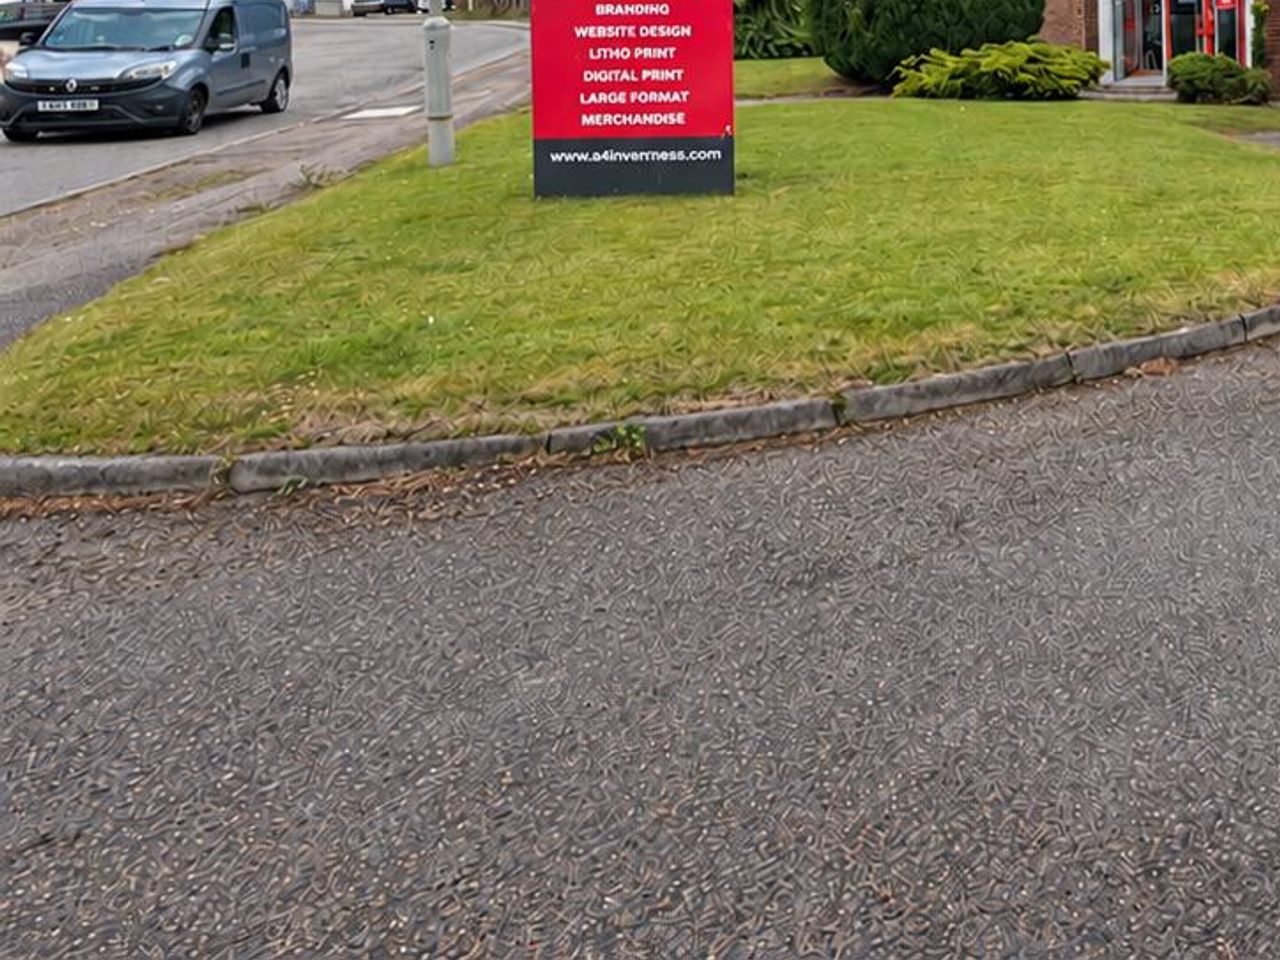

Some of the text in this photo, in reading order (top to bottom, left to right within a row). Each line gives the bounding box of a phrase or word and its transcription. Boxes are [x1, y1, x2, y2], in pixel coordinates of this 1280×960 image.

[595, 3, 670, 16] BRANDING
[574, 25, 692, 38] WEBSITE DESIGN
[588, 46, 677, 60] LITHO PRINT
[583, 69, 685, 82] DIGITAL PRINT
[579, 90, 690, 105] LARGE FORMAT
[581, 112, 687, 126] MERCHANDISE
[550, 148, 722, 162] www.a4inverness.com
